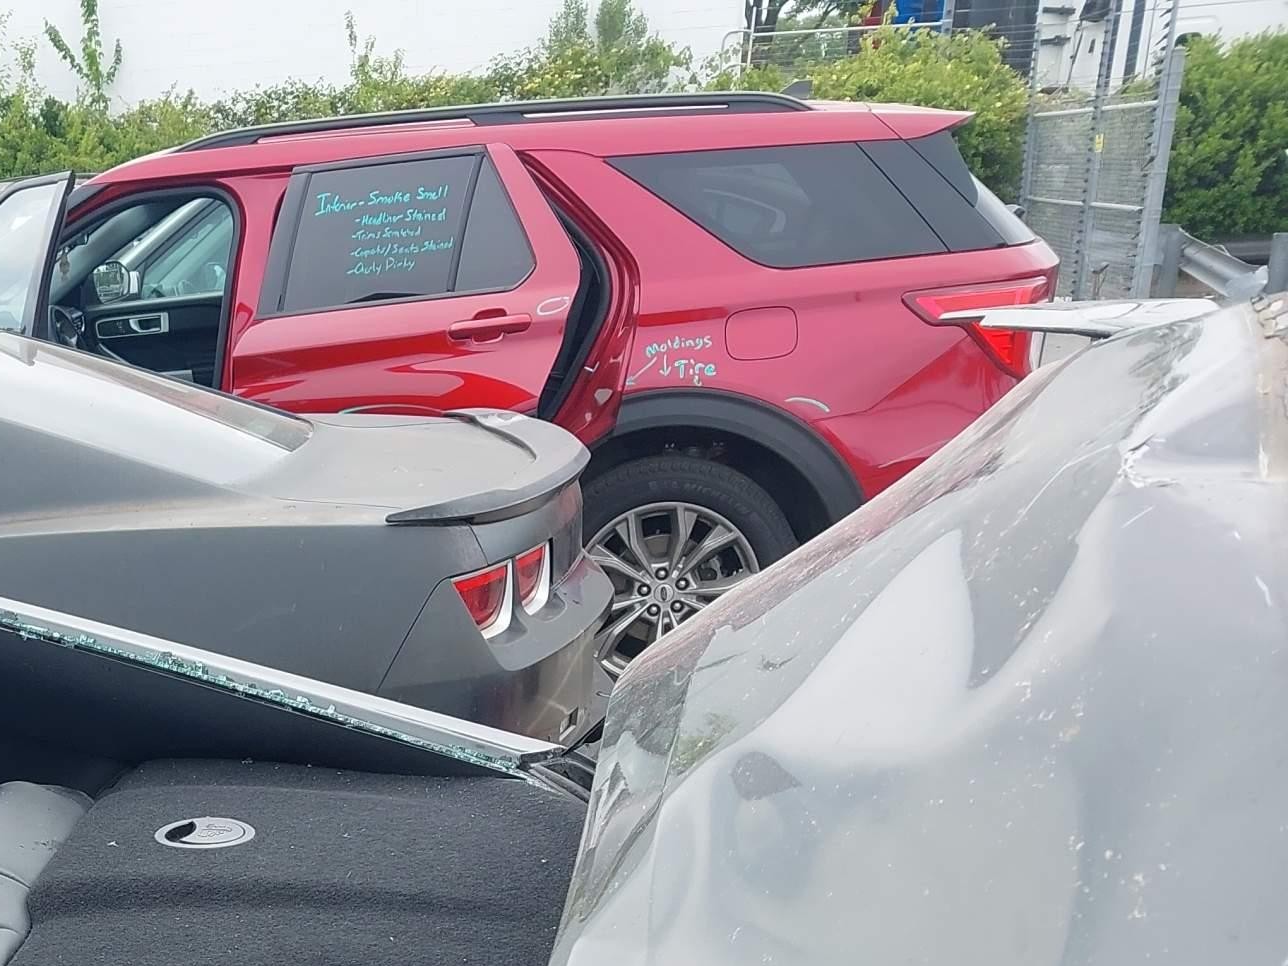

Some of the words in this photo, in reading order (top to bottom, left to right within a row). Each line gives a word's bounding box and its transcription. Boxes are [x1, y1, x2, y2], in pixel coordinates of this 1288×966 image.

[368, 190, 411, 206] Smoke
[416, 184, 449, 201] Smell
[404, 207, 447, 222] Stained
[645, 335, 713, 358] Moldings
[674, 358, 717, 379] Tire
